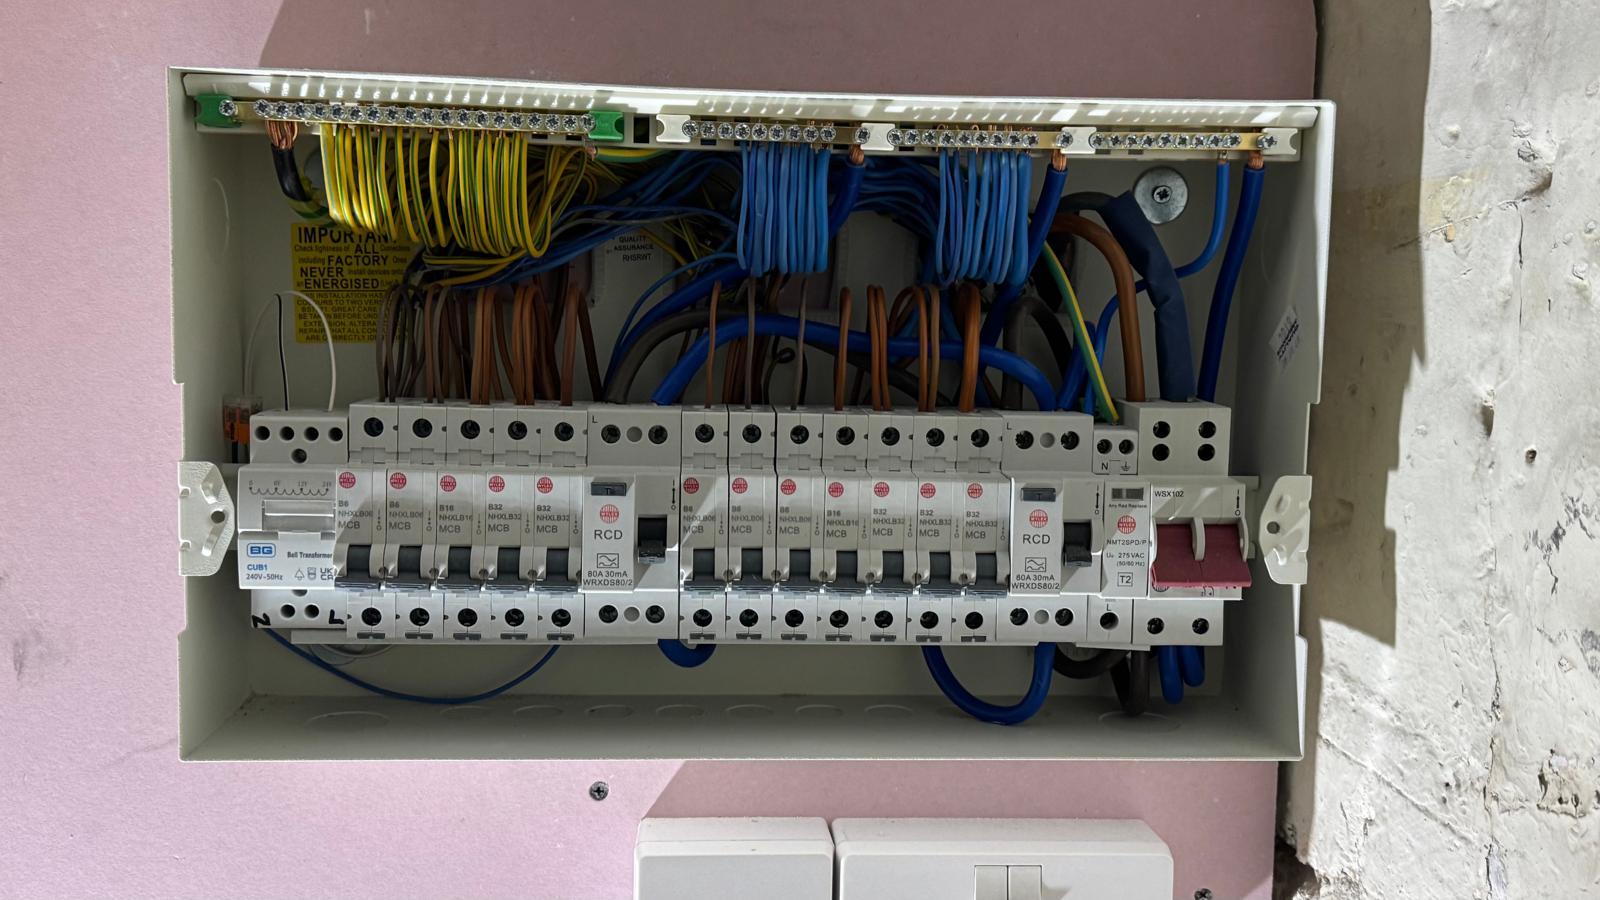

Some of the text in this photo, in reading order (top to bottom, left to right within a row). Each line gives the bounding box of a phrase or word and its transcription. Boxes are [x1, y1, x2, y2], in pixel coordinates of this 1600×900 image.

[355, 244, 379, 254] ALL
[328, 255, 388, 266] FACTORY
[300, 267, 344, 278] NEVER
[304, 278, 379, 289] ENERGISED
[1101, 462, 1109, 470] N
[338, 521, 361, 529] MCB
[389, 521, 411, 530] MCB
[439, 525, 461, 533] MCB
[488, 523, 510, 532] MCB
[536, 525, 558, 534] MCB
[683, 525, 704, 534] MCB
[731, 525, 752, 533] MCB
[594, 530, 623, 540] RCD
[779, 526, 800, 535] MCB
[826, 530, 847, 538] MCB
[872, 528, 893, 536] MCB
[919, 529, 940, 537] MCB
[965, 531, 986, 539] MCB
[1022, 534, 1051, 544] RCD
[250, 546, 273, 555] BG
[587, 570, 628, 578] 80A 30mA
[583, 578, 633, 586] WRXDS80/2
[1119, 576, 1131, 584] T2
[1011, 582, 1060, 590] WRXDS80/2
[251, 613, 271, 628] N
[328, 609, 345, 625] L
